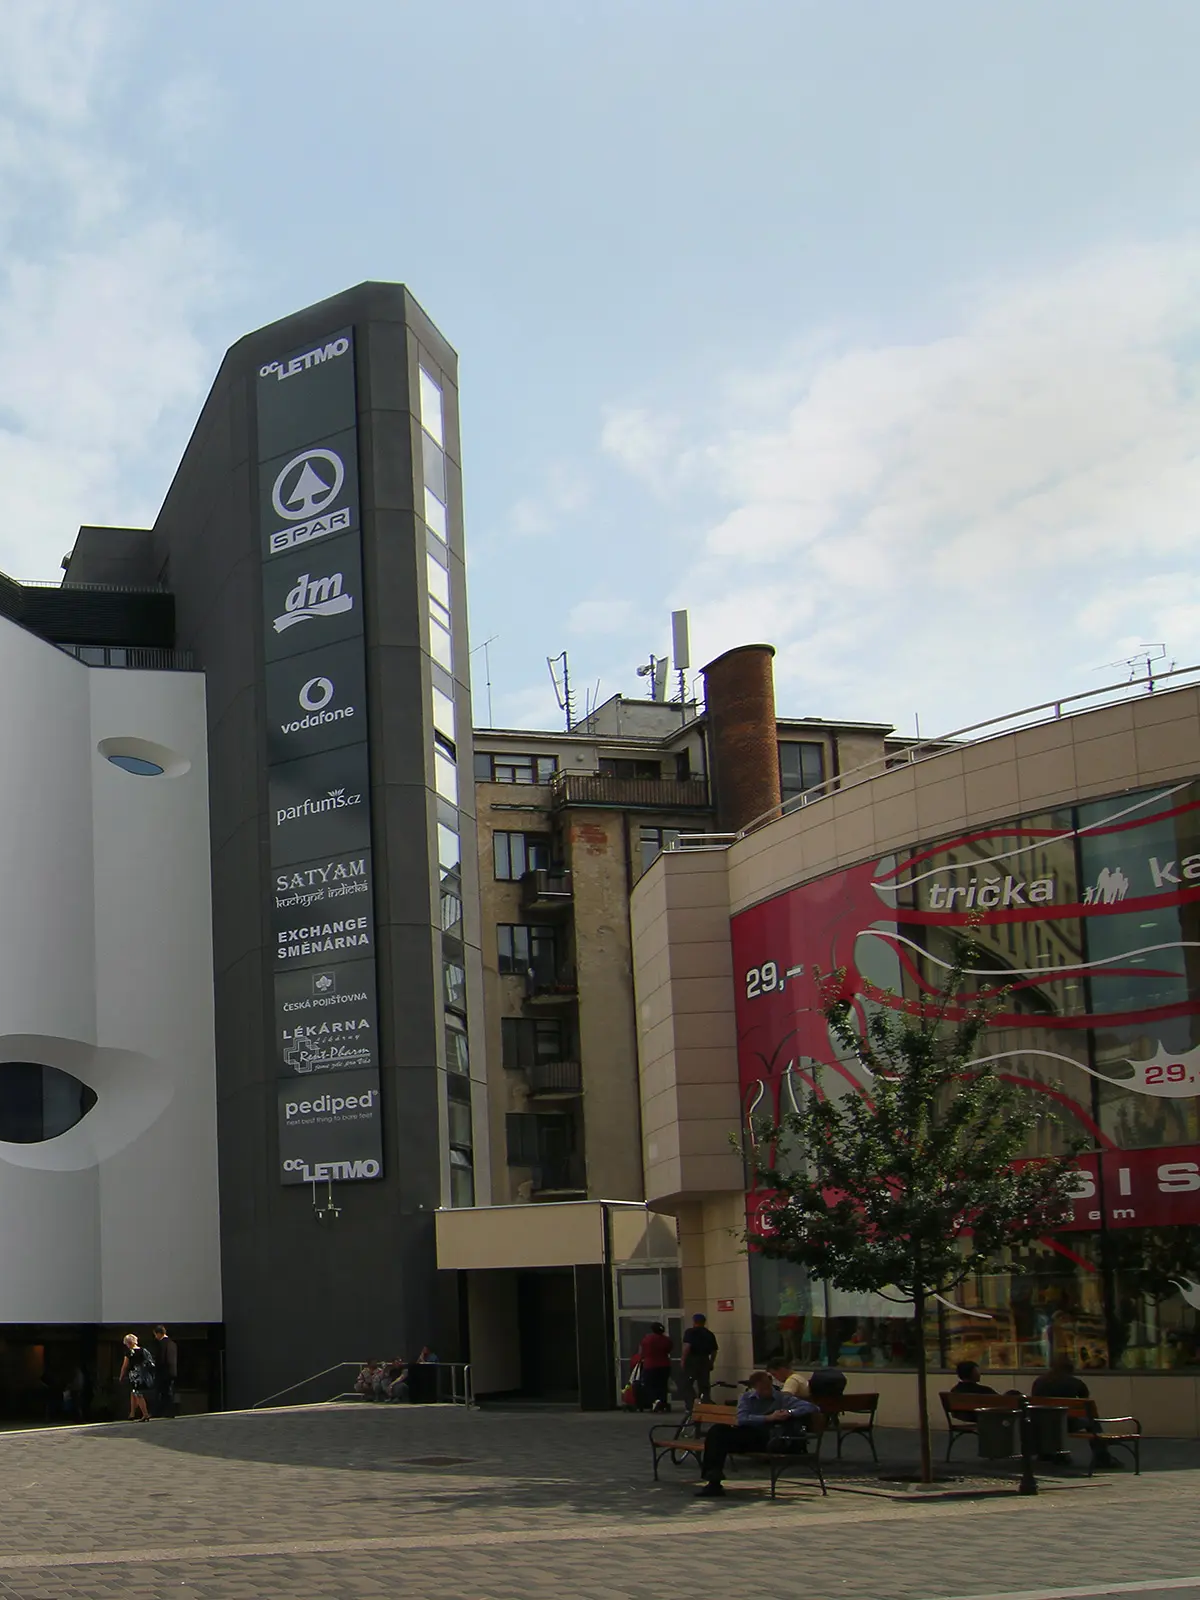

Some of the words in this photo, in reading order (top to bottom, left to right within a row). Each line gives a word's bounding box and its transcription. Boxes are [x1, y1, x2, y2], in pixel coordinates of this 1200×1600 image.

[259, 361, 280, 378] OC
[277, 338, 349, 381] LETMO
[272, 512, 347, 550] SPAR
[285, 572, 343, 612] dm
[281, 705, 355, 734] vodafone
[276, 791, 361, 826] parfums.cz
[277, 859, 366, 891] SATYAM
[275, 888, 324, 908] kuchyně
[327, 879, 369, 899] indická
[929, 875, 1054, 909] trička
[278, 916, 368, 943] EXCHANGE
[277, 933, 369, 959] SMĚNÁRNA
[283, 1000, 311, 1012] ČESKÁ
[312, 992, 368, 1007] POJIŠŤOVNA
[282, 1019, 370, 1040] LÉKÁRNA
[283, 1158, 305, 1172] OC
[302, 1159, 380, 1182] LETMO
